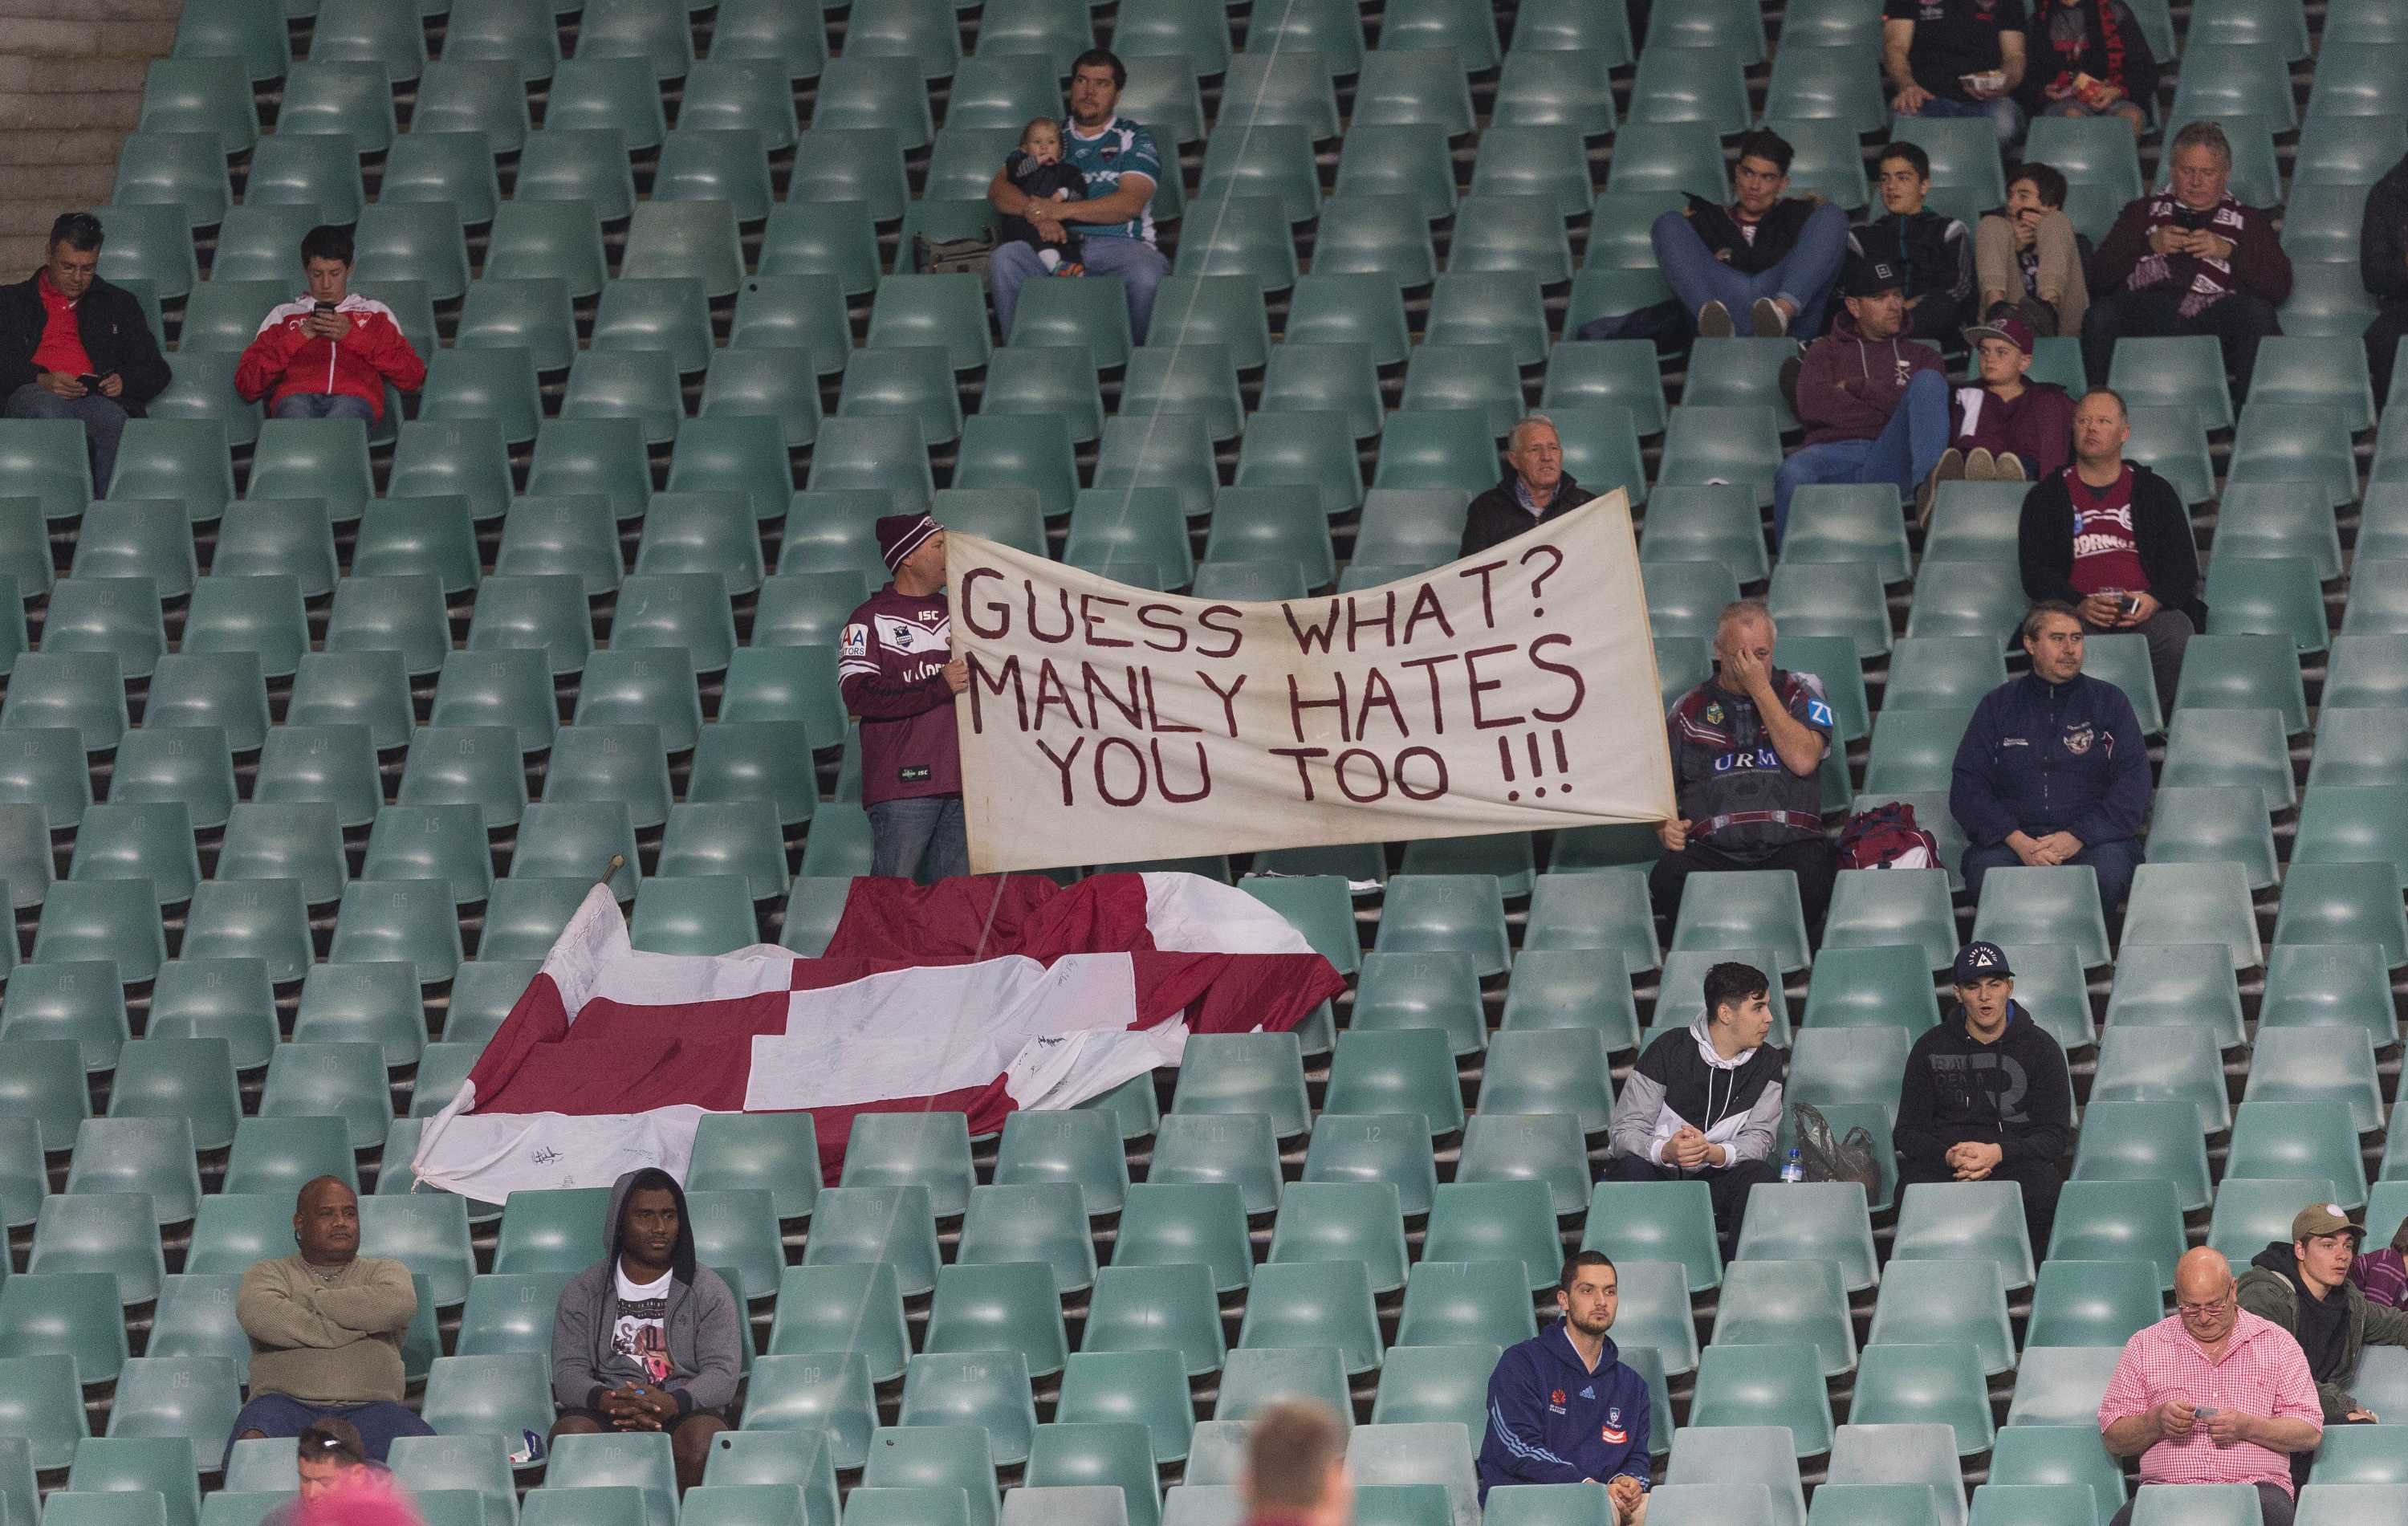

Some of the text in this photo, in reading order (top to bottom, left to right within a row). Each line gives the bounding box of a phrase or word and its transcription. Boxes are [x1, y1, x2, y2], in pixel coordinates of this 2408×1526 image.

[961, 543, 1564, 658] GUESS WHAT?
[918, 610, 939, 621] ISC
[843, 647, 864, 656] TORS
[965, 633, 1586, 743] MANLY HATES
[459, 739, 475, 755] 05
[1714, 748, 1778, 771] URM
[1036, 729, 1574, 808] YOU TOO !!!
[425, 817, 440, 833] 15
[392, 893, 408, 909] 05
[1413, 963, 1428, 979] 12
[59, 975, 75, 991] 03
[1236, 1045, 1251, 1061] 11
[1211, 1126, 1226, 1142] 11
[1365, 1126, 1381, 1142] 12
[867, 1200, 883, 1216] 09
[213, 1288, 230, 1304] 05
[521, 1286, 537, 1303] 07
[173, 1371, 189, 1389] 05
[804, 1366, 820, 1384] 09
[962, 1365, 978, 1382] 10
